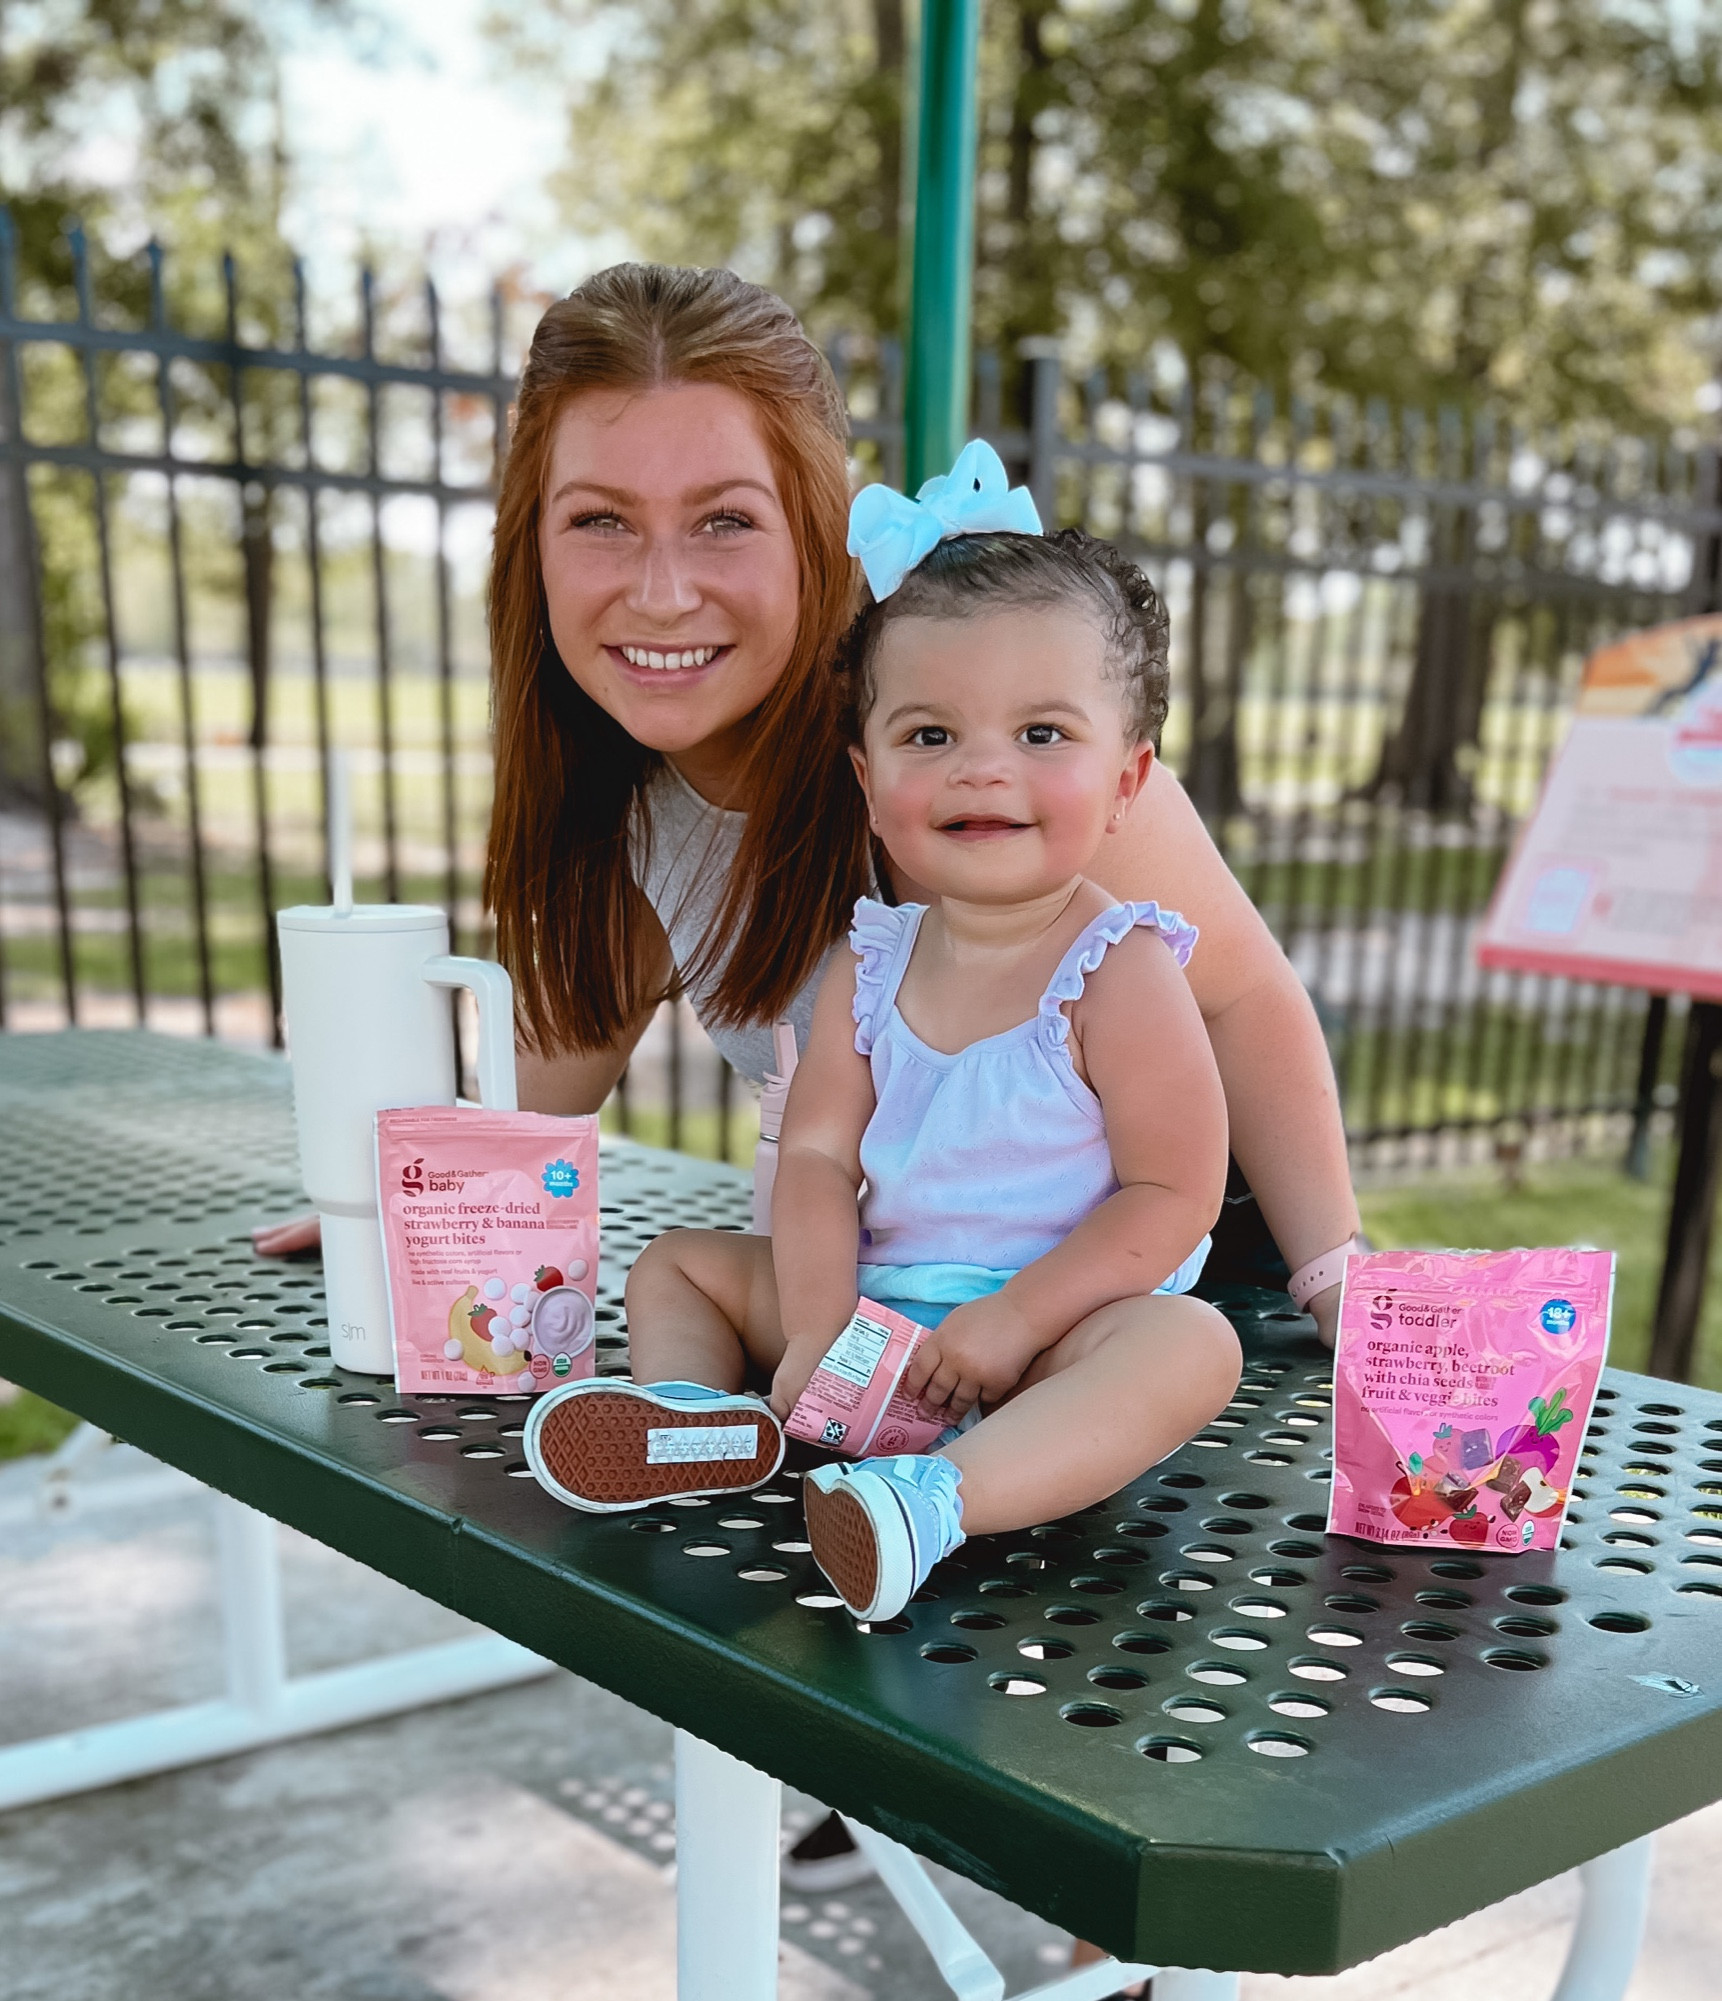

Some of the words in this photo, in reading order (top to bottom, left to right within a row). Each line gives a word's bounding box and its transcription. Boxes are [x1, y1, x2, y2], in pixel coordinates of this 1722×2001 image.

[550, 1170, 572, 1181] 10+
[429, 1179, 465, 1194] baby
[403, 1203, 456, 1218] organic
[458, 1202, 541, 1215] freeze-dried
[404, 1218, 478, 1232] strawberry
[481, 1217, 494, 1229] &
[497, 1217, 545, 1230] banana
[405, 1234, 450, 1248] yogurt
[452, 1233, 486, 1245] bites
[1547, 1306, 1571, 1319] 18+
[1399, 1314, 1457, 1329] toddler
[1367, 1340, 1423, 1354] organic
[1425, 1343, 1469, 1359] apple,
[1365, 1356, 1448, 1375] strawberry,
[1452, 1360, 1515, 1376] beetroot
[1364, 1371, 1396, 1384] with
[1400, 1373, 1430, 1387] chia
[1433, 1376, 1473, 1389] seeds
[1361, 1386, 1396, 1400] fruit
[1399, 1388, 1411, 1401] &
[1414, 1392, 1462, 1407] veggie
[1463, 1392, 1499, 1407] bites
[1372, 1406, 1402, 1415] artificial
[1439, 1411, 1472, 1420] synthetic
[1474, 1413, 1498, 1421] colors
